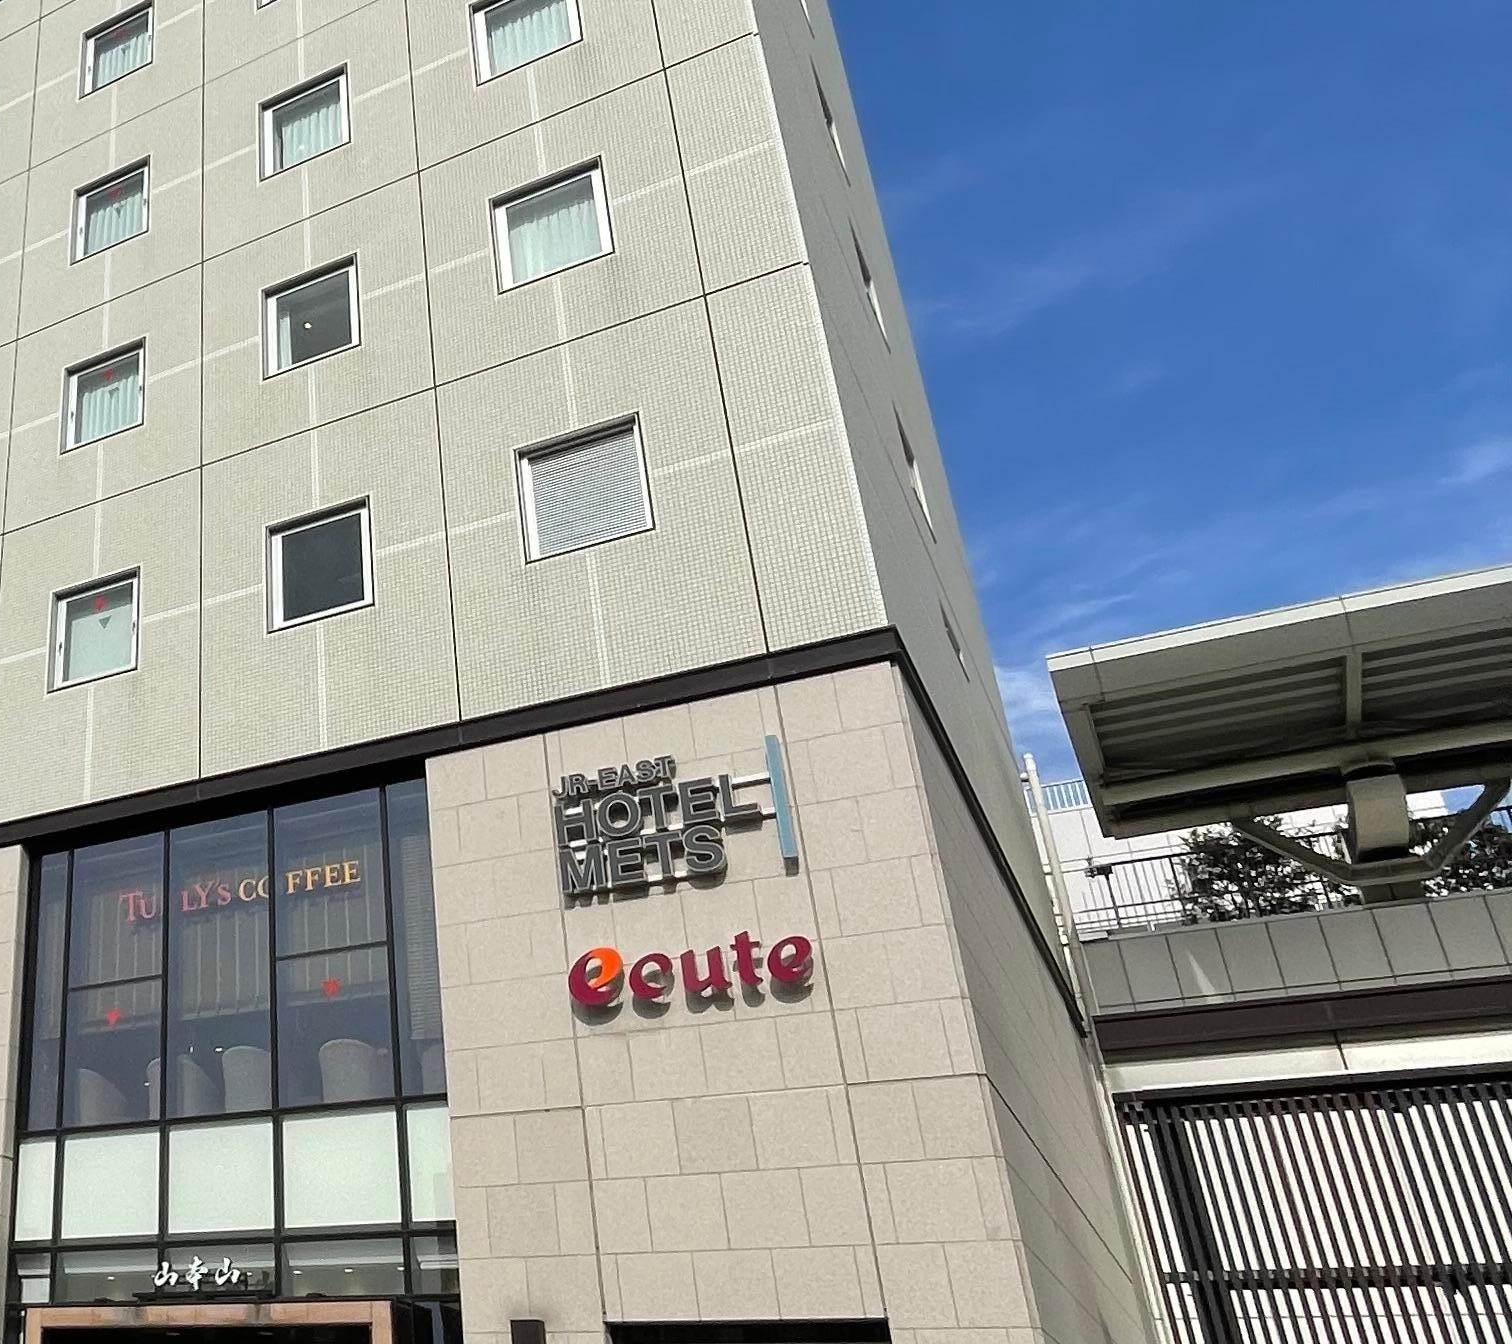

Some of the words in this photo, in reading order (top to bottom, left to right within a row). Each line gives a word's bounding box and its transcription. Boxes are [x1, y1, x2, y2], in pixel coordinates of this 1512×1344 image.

[552, 755, 675, 798] JR-EAST
[555, 774, 759, 847] HOTEL
[561, 825, 727, 894] METS
[568, 930, 813, 1006] ecute
[153, 1256, 240, 1291] 山本山
